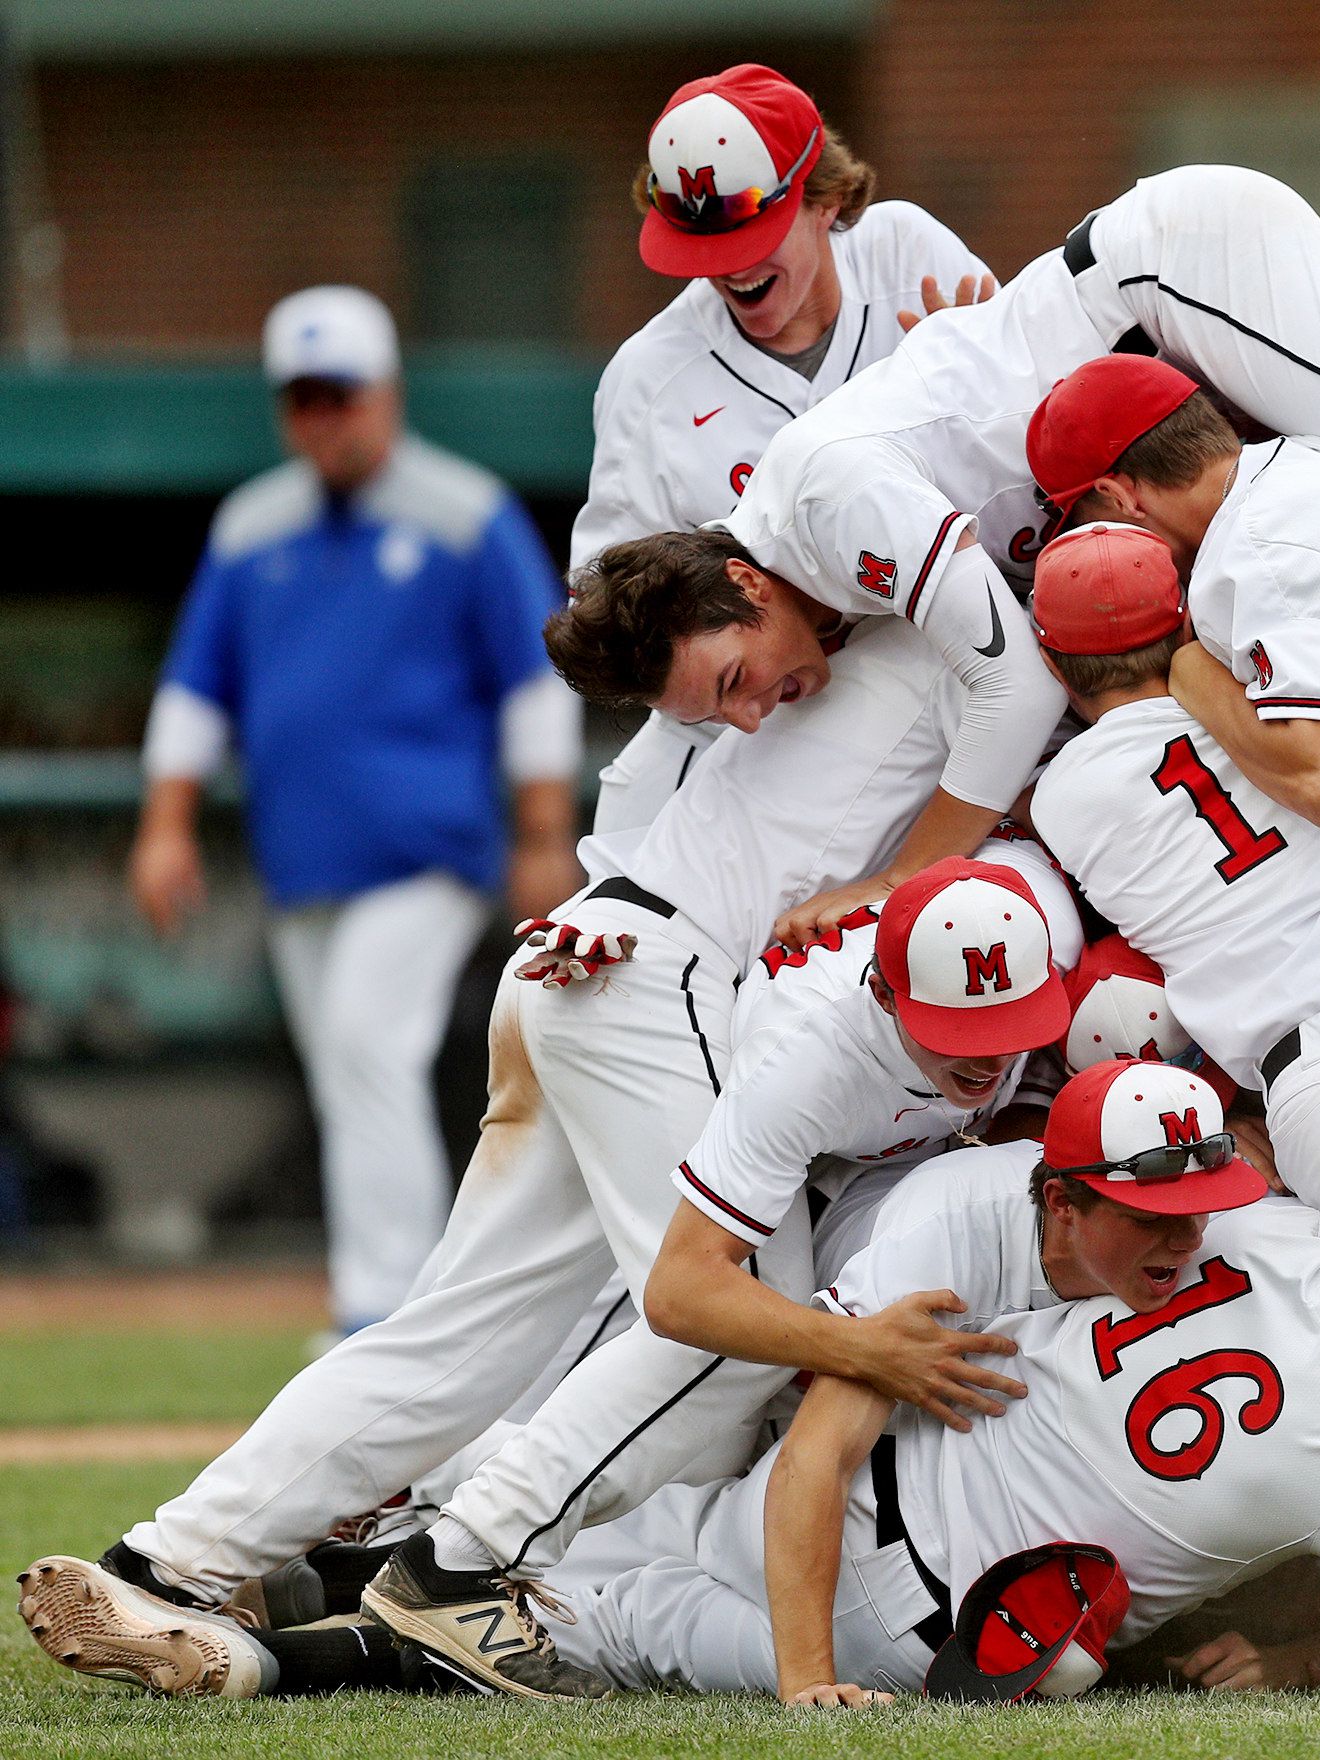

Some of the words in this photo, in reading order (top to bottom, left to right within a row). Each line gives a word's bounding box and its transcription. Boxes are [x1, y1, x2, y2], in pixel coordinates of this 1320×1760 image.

[677, 165, 718, 199] M
[857, 550, 898, 599] M
[1150, 734, 1287, 885] 1
[962, 941, 1012, 996] M
[1158, 1107, 1202, 1146] M
[1092, 1255, 1285, 1481] 16
[455, 1606, 526, 1654] N
